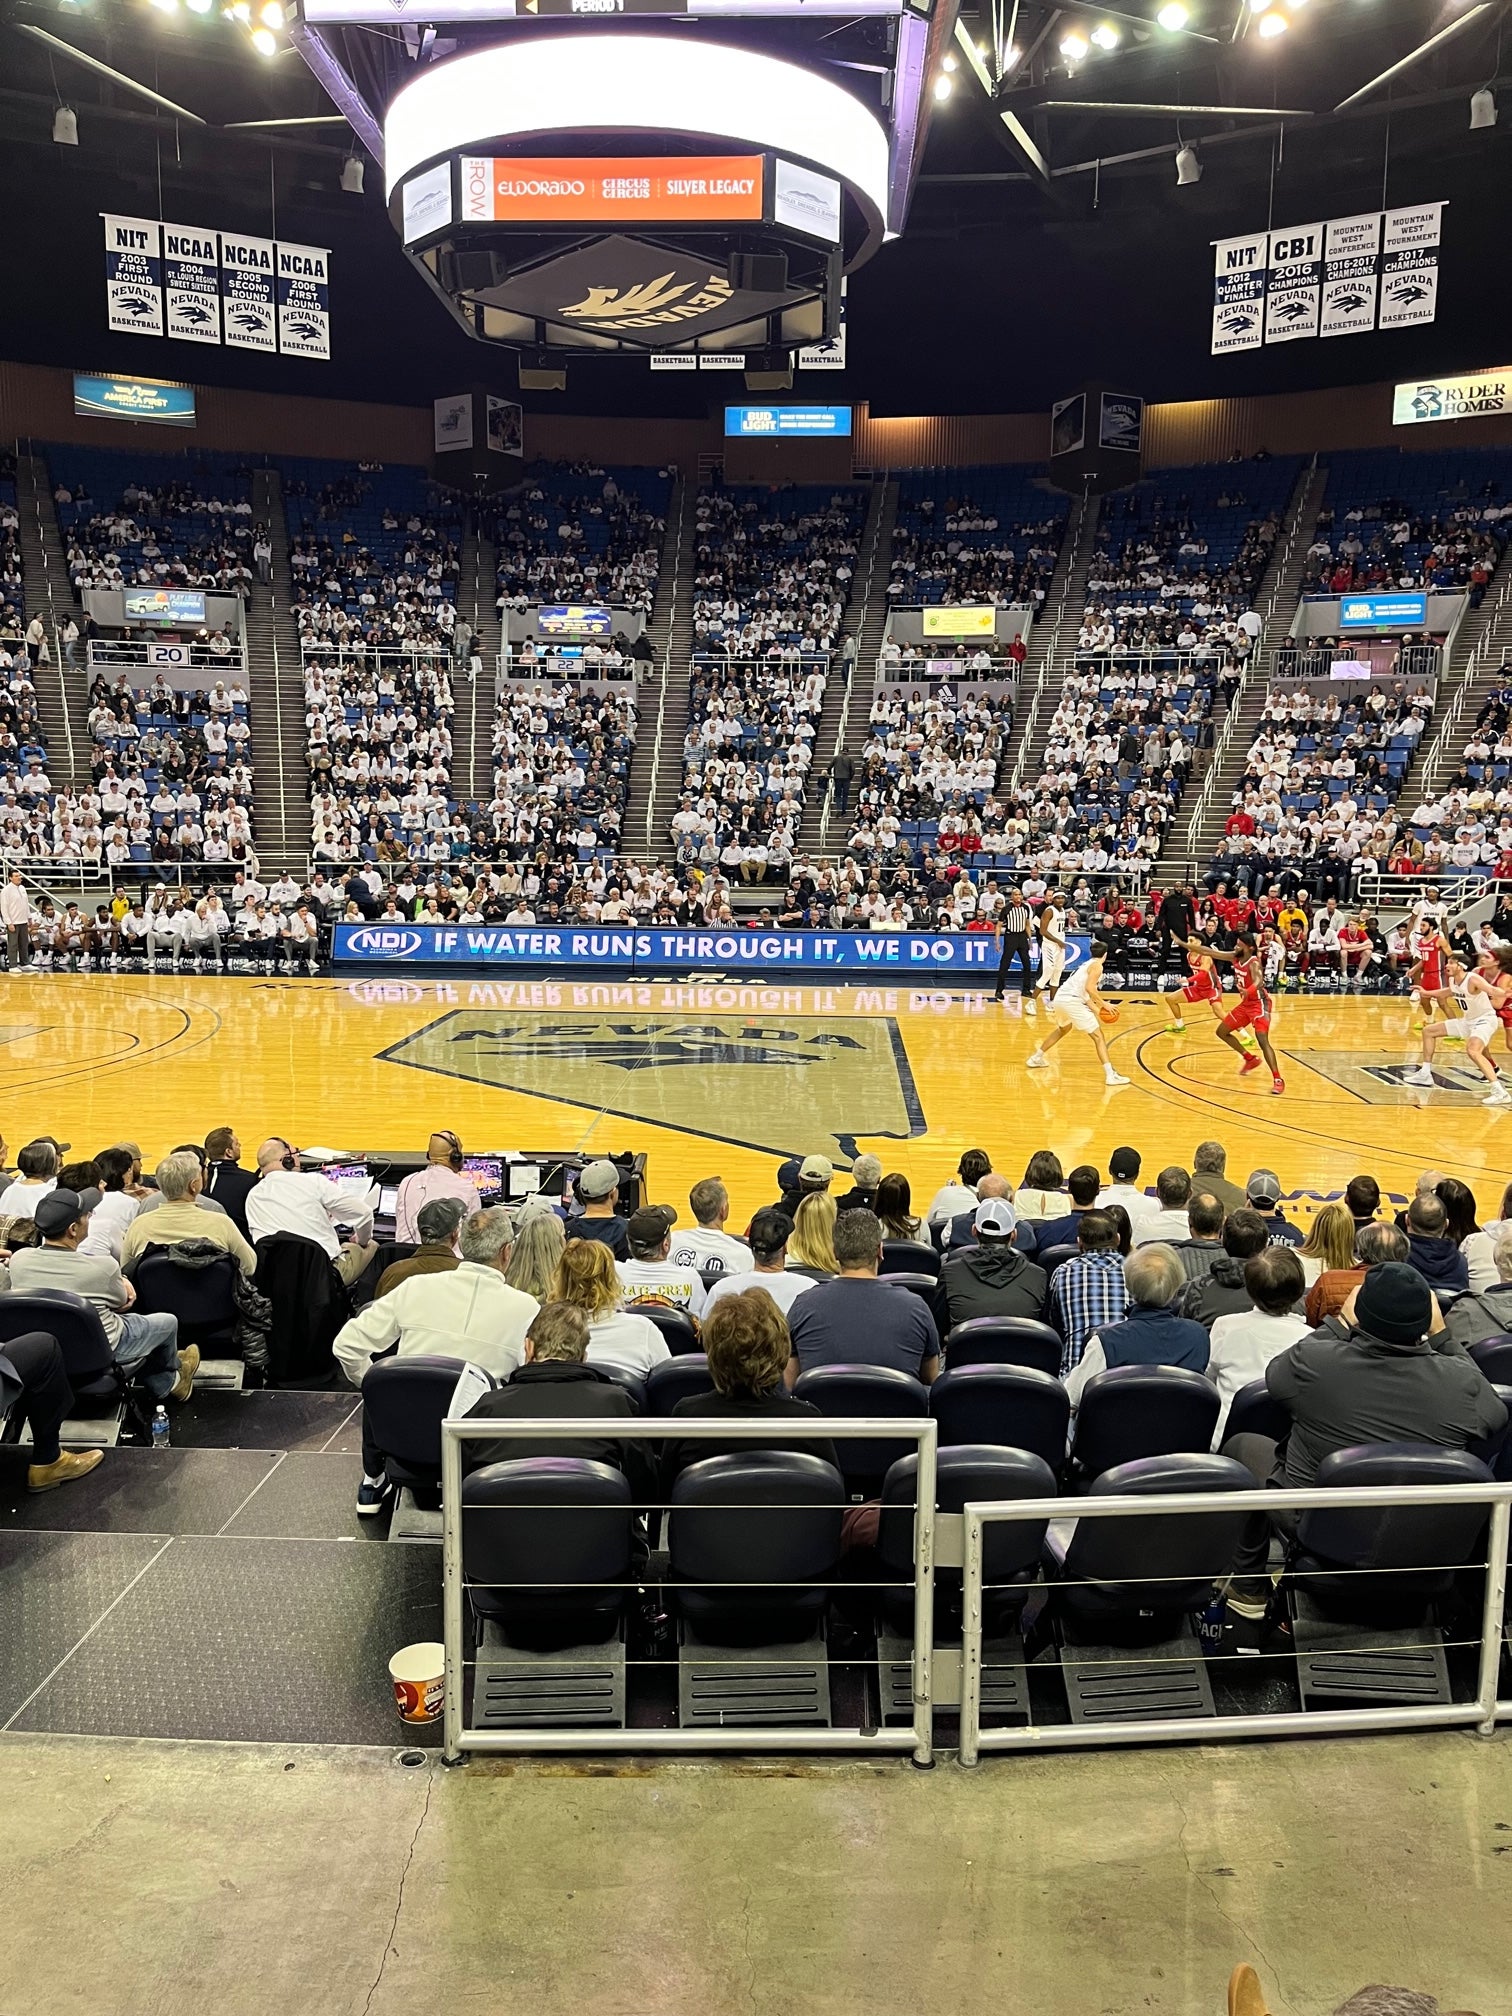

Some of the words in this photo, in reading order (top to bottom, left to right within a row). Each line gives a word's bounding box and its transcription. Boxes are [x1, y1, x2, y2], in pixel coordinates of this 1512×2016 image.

[572, 0, 615, 12] PERIOD
[618, 0, 624, 12] 1
[498, 180, 585, 196] ELDORADO
[602, 178, 651, 189] CIRCUS
[667, 180, 707, 197] SILVER
[710, 179, 755, 195] LEGACY
[470, 166, 486, 217] ROW
[602, 188, 651, 199] CIRCUS
[1393, 214, 1434, 226] MOUNTAIN
[1333, 224, 1373, 236] MOUNTAIN
[1401, 225, 1424, 234] WEST
[116, 228, 148, 249] NIT
[1341, 234, 1364, 244] WEST
[1386, 232, 1438, 246] TOURNAMENT
[168, 236, 214, 260] NCAA
[1274, 236, 1314, 261] CBI
[1328, 242, 1376, 255] CONFERENCE
[120, 254, 147, 265] 2003
[225, 245, 270, 269] NCAA
[1226, 247, 1256, 268] NIT
[1398, 249, 1425, 261] 2017
[118, 263, 150, 274] FIRST
[180, 264, 204, 274] 2004
[280, 254, 324, 278] NCAA
[1326, 256, 1376, 271] 2016-2017
[1385, 257, 1437, 272] CHAMPIONS
[115, 272, 153, 285] ROUND
[168, 271, 176, 279] ST.
[178, 272, 194, 282] LOUIS
[196, 276, 217, 285] REGION
[236, 272, 262, 282] 2005
[1274, 264, 1312, 280] 2016
[1327, 266, 1374, 280] CHAMPIONS
[1227, 273, 1251, 285] 2012
[1268, 275, 1319, 290] CHAMPIONS
[1385, 275, 1433, 294] NEVADA
[170, 280, 190, 289] SWEET
[191, 282, 216, 293] SIXTEEN
[228, 280, 270, 293] SECOND
[291, 280, 316, 292] 2006
[1217, 280, 1262, 296] QUARTER
[1326, 283, 1372, 302] NEVADA
[112, 286, 158, 304] NEVADA
[231, 290, 268, 302] ROUND
[289, 290, 318, 300] FIRST
[1224, 290, 1255, 302] FINALS
[1270, 291, 1315, 310] NEVADA
[170, 294, 216, 312] NEVADA
[286, 298, 322, 311] ROUND
[579, 275, 735, 330] NEVADA
[228, 302, 272, 321] NEVADA
[1216, 304, 1260, 323] NEVADA
[1382, 310, 1433, 323] BASKETBALL
[112, 317, 160, 329] BASKETBALL
[282, 312, 326, 329] NEVADA
[1322, 318, 1372, 331] BASKETBALL
[171, 325, 218, 337] BASKETBALL
[1267, 322, 1315, 336] BASKETBALL
[228, 333, 274, 346] BASKETBALL
[1214, 336, 1259, 348] BASKETBALL
[282, 341, 328, 354] BASKETBALL
[702, 356, 744, 364] BASKETBALL
[801, 356, 844, 364] BASKETBALL
[1445, 383, 1506, 401] RYDER
[104, 392, 142, 404] AMERICA
[144, 397, 168, 407] FIRST
[1443, 398, 1504, 415] HOMES
[747, 411, 772, 420] BUD
[742, 420, 776, 430] LIGHT
[1344, 611, 1373, 619] LIGHT
[156, 648, 182, 662] 20
[558, 660, 574, 670] 22
[936, 662, 953, 672] 24
[362, 932, 407, 948] NDI
[435, 932, 457, 952] IF
[467, 932, 568, 956] WATER
[572, 935, 652, 958] RUNS
[661, 936, 802, 960] THROUGH
[815, 939, 846, 963] IT,
[855, 940, 899, 960] WE
[911, 940, 955, 962] DO
[965, 941, 988, 962] IT
[1422, 951, 1430, 961] 10
[626, 976, 768, 984] NEVADA
[1134, 972, 1152, 980] NSB
[1456, 998, 1468, 1010] 10
[446, 1024, 867, 1050] NEVADA
[620, 1284, 650, 1296] RATE
[658, 1284, 692, 1296] CREW
